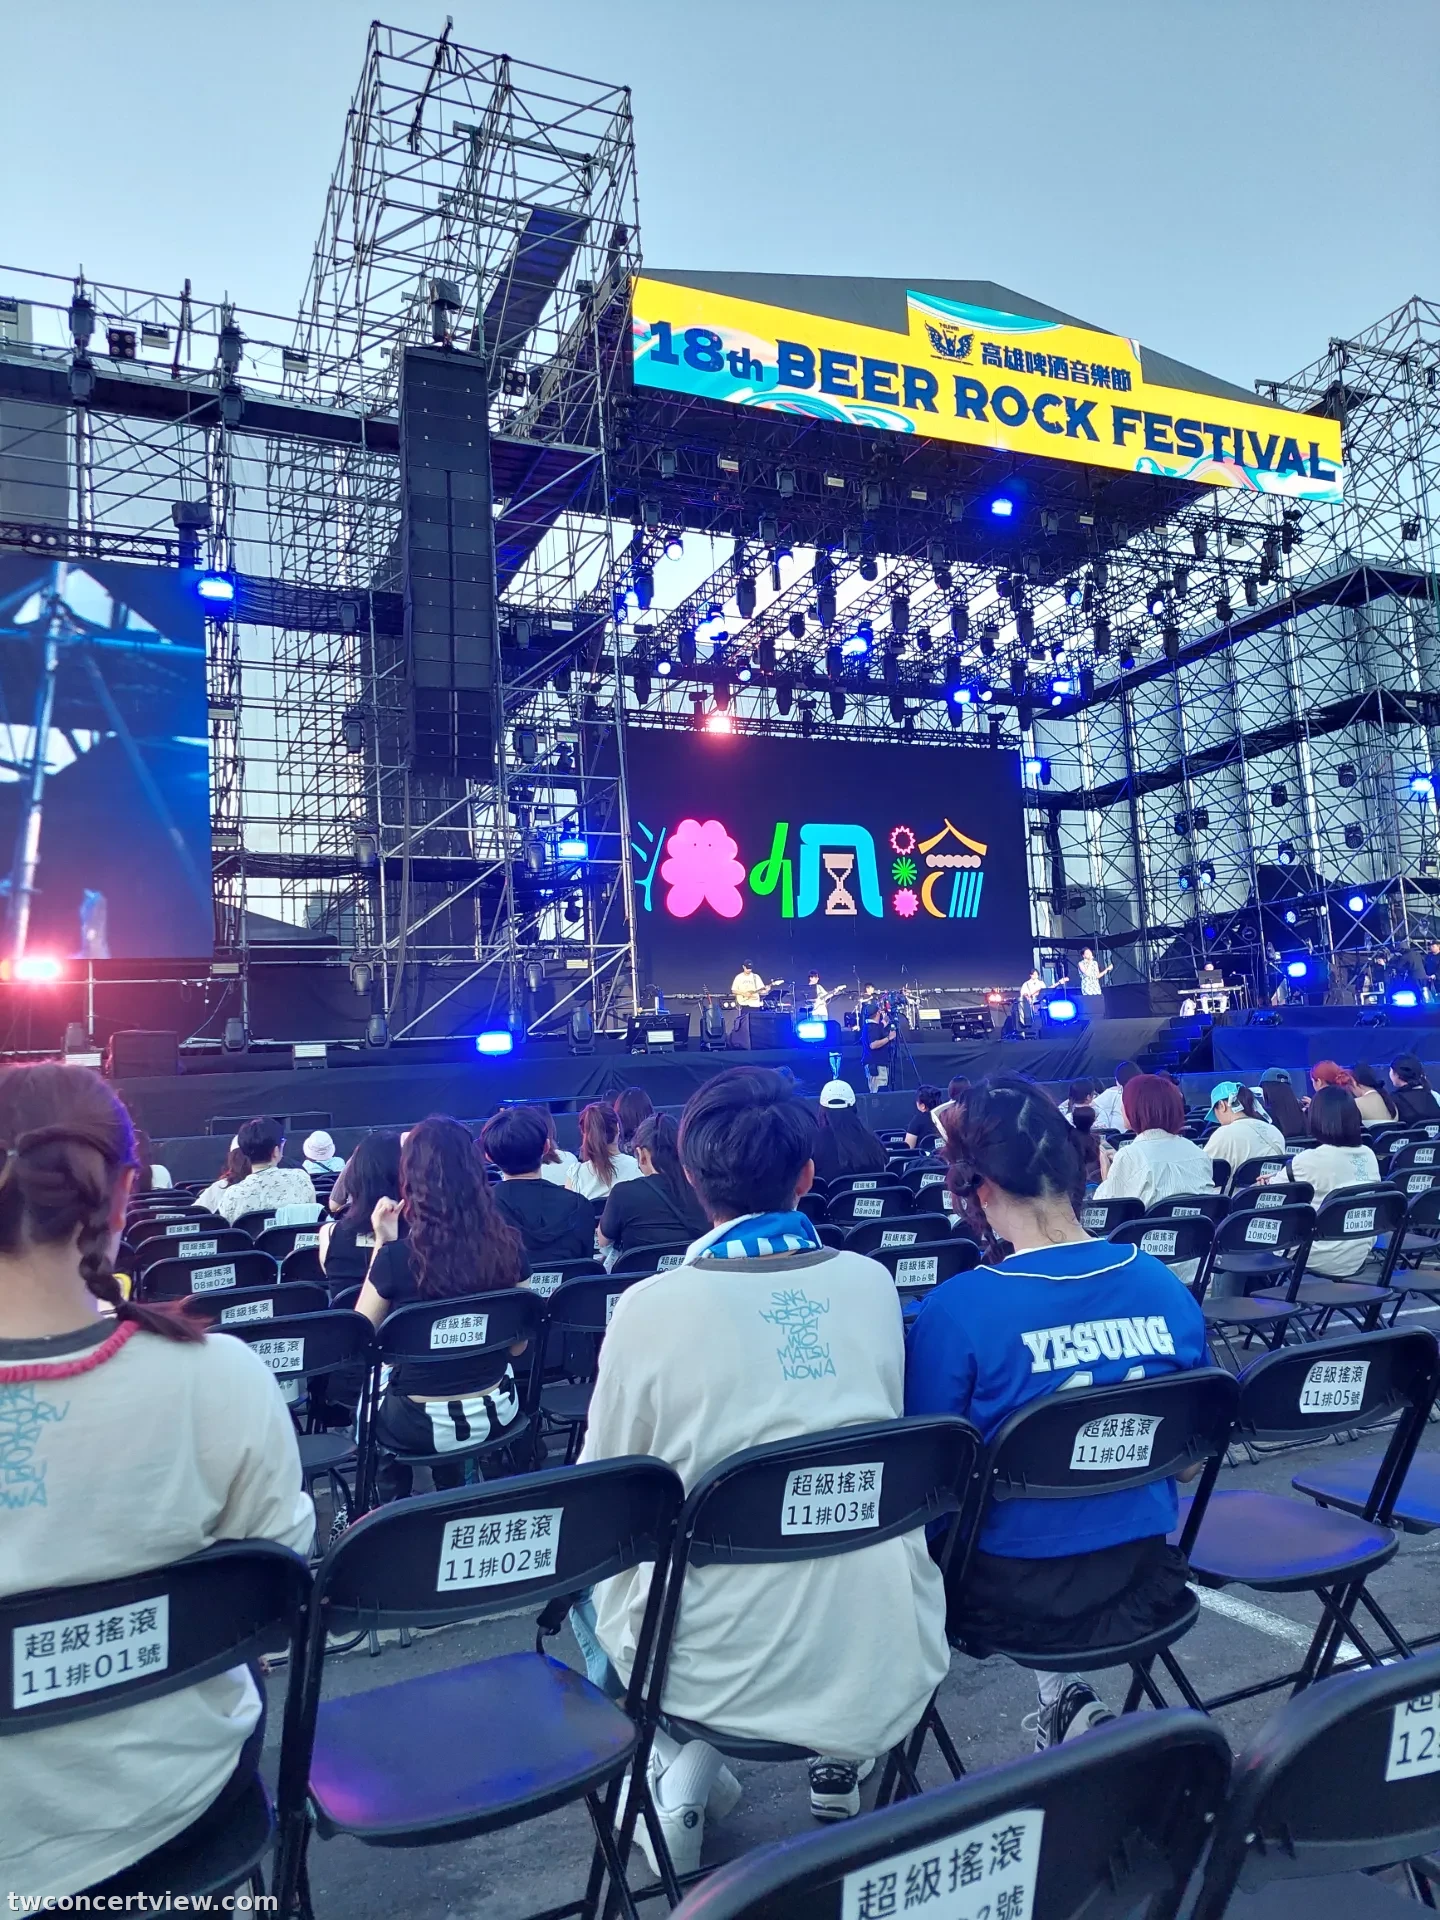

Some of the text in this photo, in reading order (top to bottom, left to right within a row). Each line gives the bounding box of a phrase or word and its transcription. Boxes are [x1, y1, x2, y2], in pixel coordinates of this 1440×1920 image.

[980, 342, 1132, 392] 高雄啤酒音樂節
[649, 320, 1337, 482] 18th BEER ROCK FESTIVAL
[899, 1259, 935, 1271] 超級搖滾
[225, 1302, 270, 1319] 超級搖滾
[435, 1316, 484, 1330] 超級搖滾
[432, 1331, 484, 1345] 10排03號
[1020, 1315, 1176, 1374] YESUNG
[1308, 1366, 1365, 1384] 超級搖滾
[1302, 1389, 1361, 1407] 11排05號
[1082, 1417, 1155, 1438] 超級搖滾
[1075, 1443, 1149, 1463] 11排04號
[791, 1469, 876, 1496] 超級搖滾
[786, 1501, 875, 1526] 11排03號
[450, 1514, 553, 1550] 超級搖滾
[444, 1548, 552, 1582] 11排02號
[24, 1606, 159, 1661] 超級搖滾
[21, 1643, 162, 1696] 11排01號
[857, 1824, 1027, 1920] 超級搖滾
